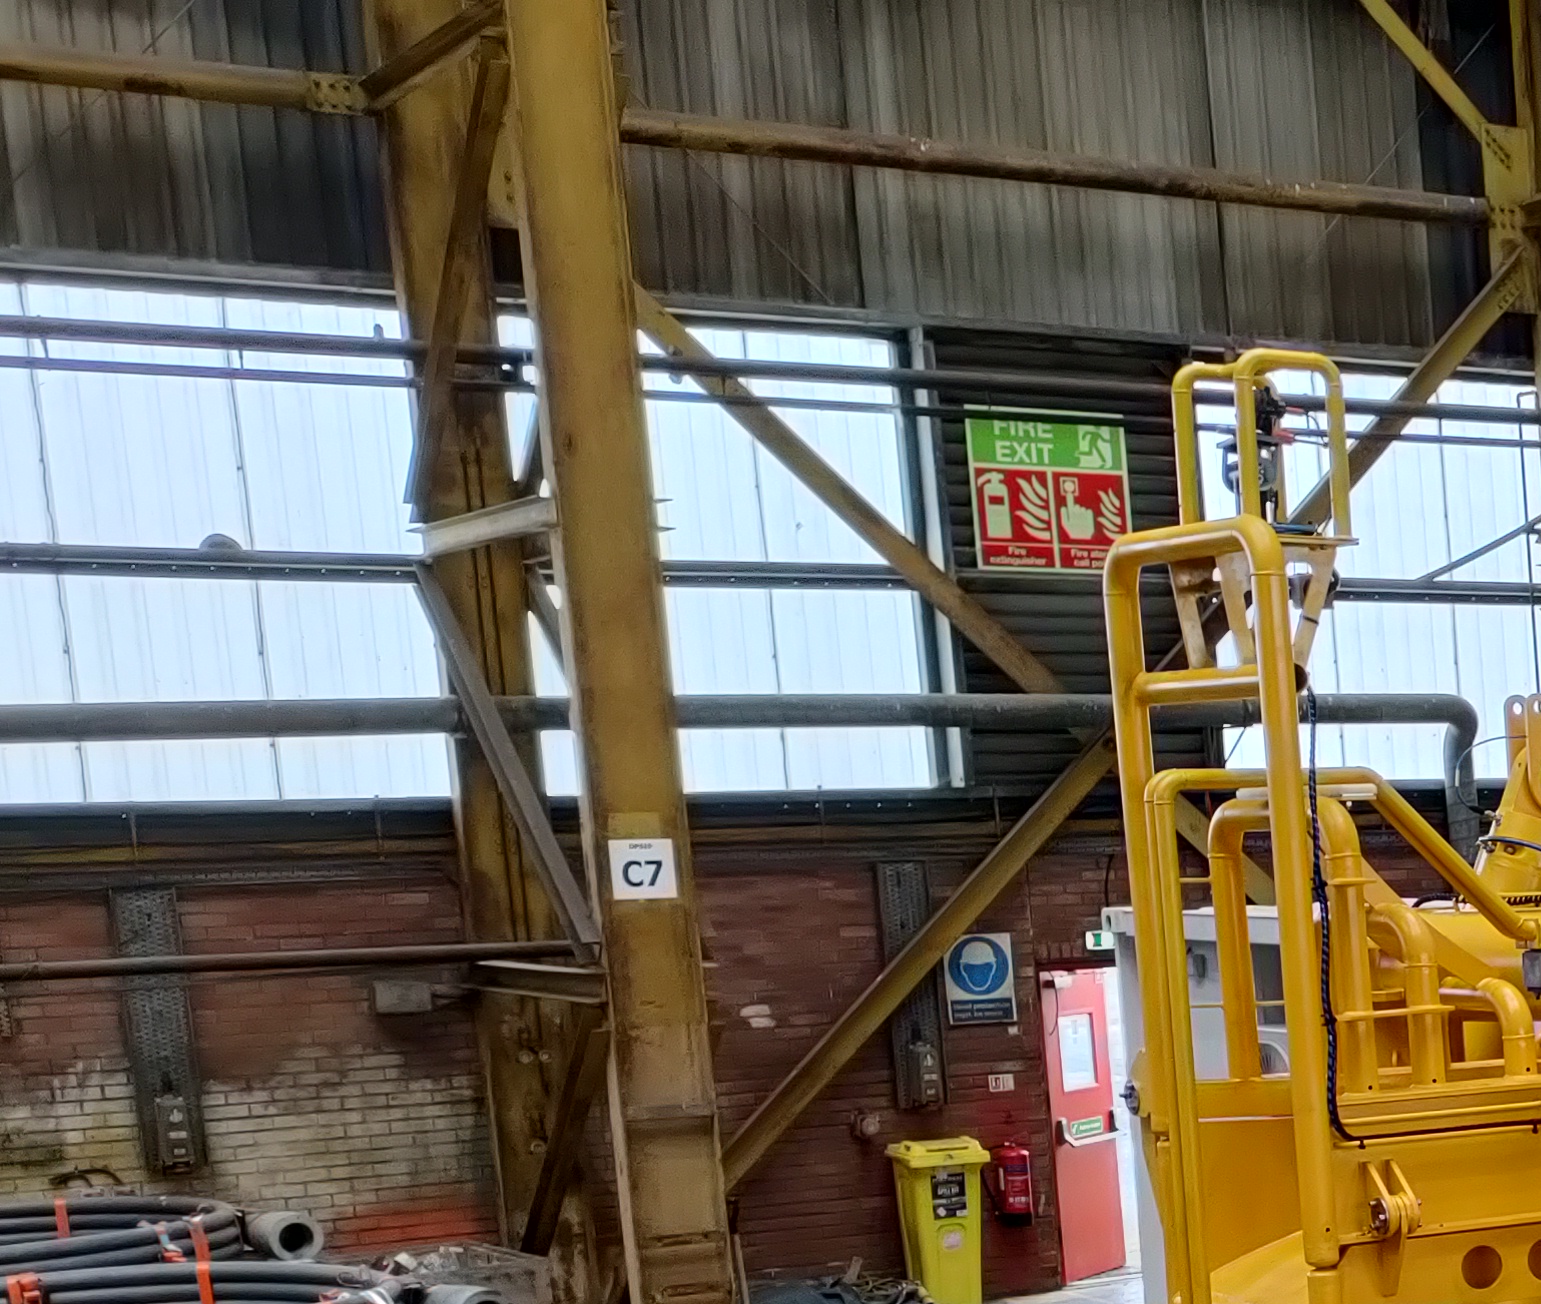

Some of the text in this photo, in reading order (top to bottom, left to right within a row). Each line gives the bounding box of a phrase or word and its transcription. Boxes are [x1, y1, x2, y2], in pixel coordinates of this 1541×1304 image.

[993, 419, 1054, 439] FIRE
[995, 440, 1054, 465] EXIT
[1008, 546, 1027, 556] Fire
[1071, 548, 1089, 558] Fire
[622, 860, 663, 887] C7
